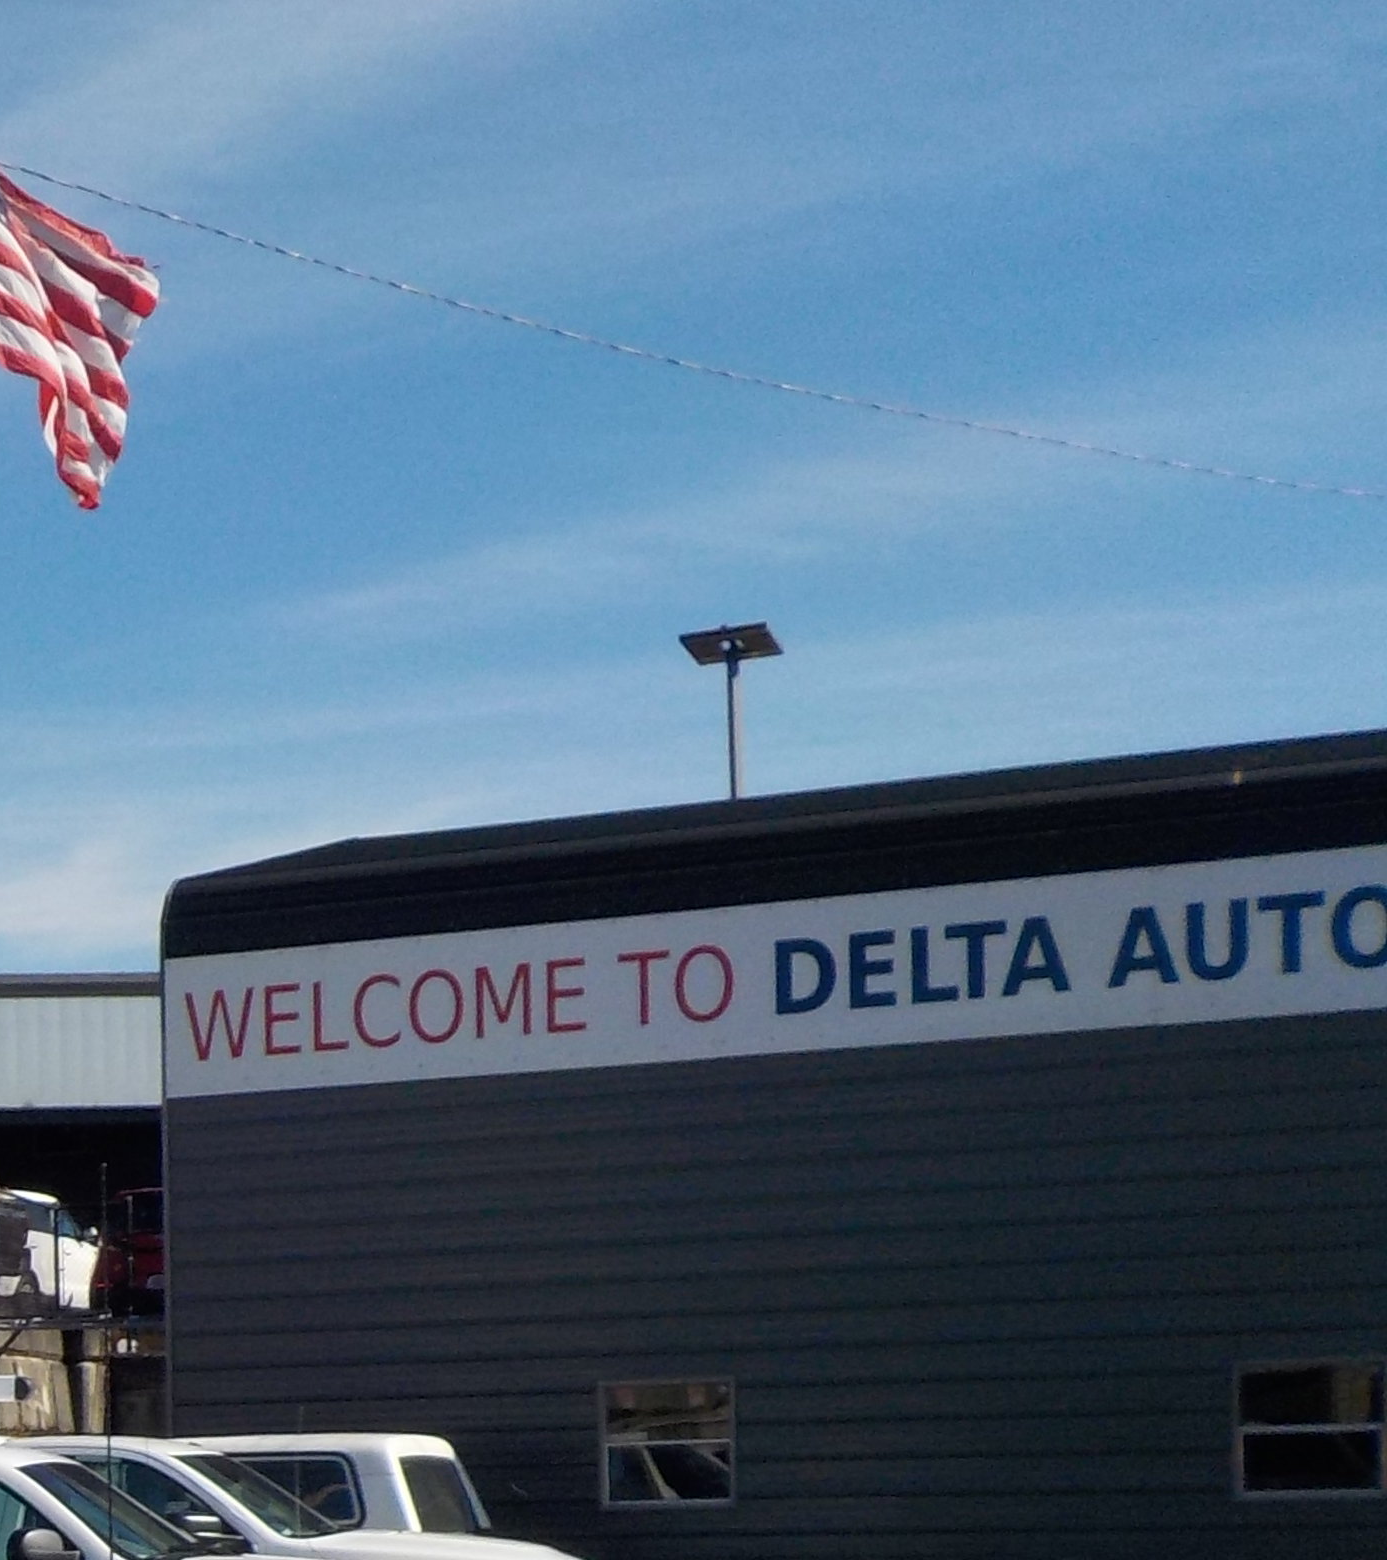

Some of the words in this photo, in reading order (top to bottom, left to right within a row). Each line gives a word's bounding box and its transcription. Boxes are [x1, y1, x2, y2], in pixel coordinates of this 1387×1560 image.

[184, 956, 587, 1062] WELCOME
[617, 943, 735, 1027] TO
[772, 915, 1072, 1016] DELTA
[1107, 882, 1387, 990] AUTO
